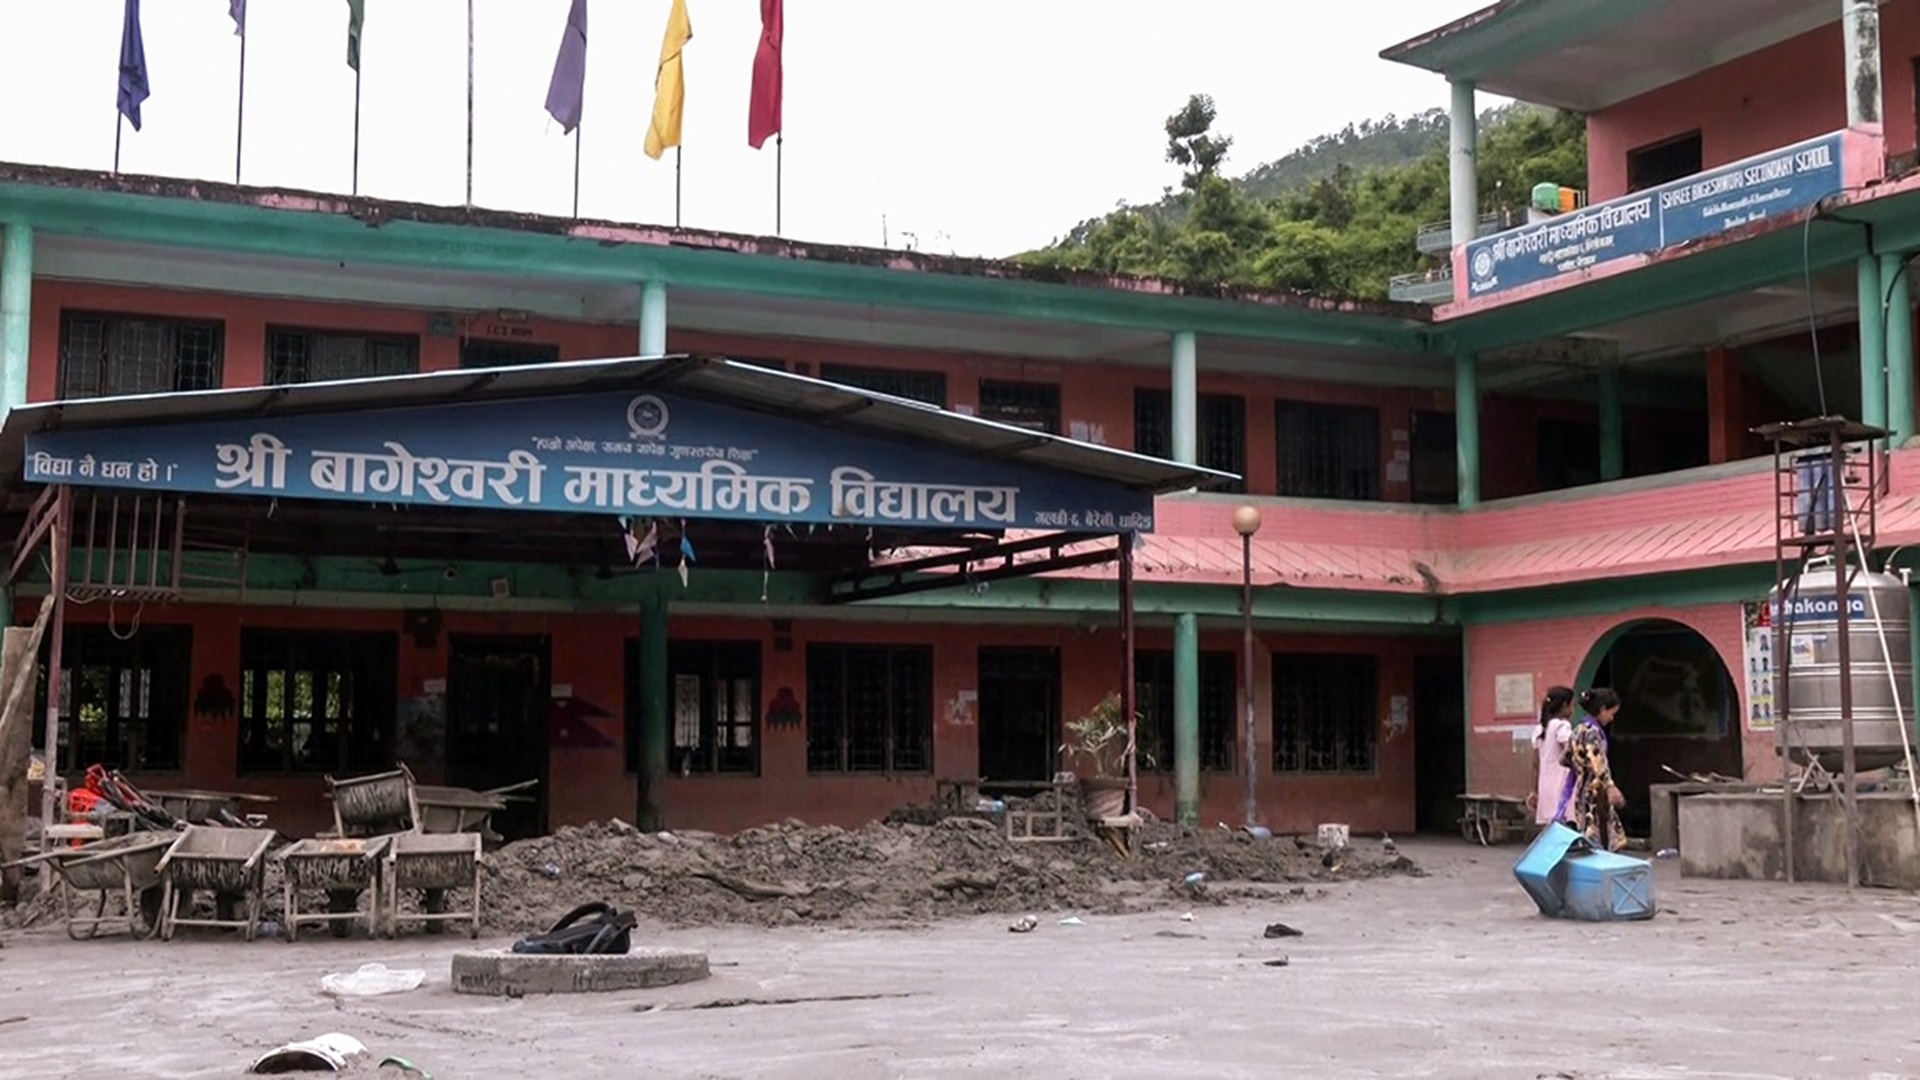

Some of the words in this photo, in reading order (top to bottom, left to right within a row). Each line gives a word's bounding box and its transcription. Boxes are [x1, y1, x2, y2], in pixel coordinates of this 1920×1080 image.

[1795, 145, 1833, 172] SCHOOL
[1599, 198, 1652, 231] विद्यालय
[79, 453, 96, 477] नै
[138, 458, 158, 482] हो
[215, 433, 292, 489] श्री
[310, 441, 547, 505] बागेश्वरी
[564, 459, 813, 516] माध्यमिक
[831, 466, 1020, 524] विद्यालय
